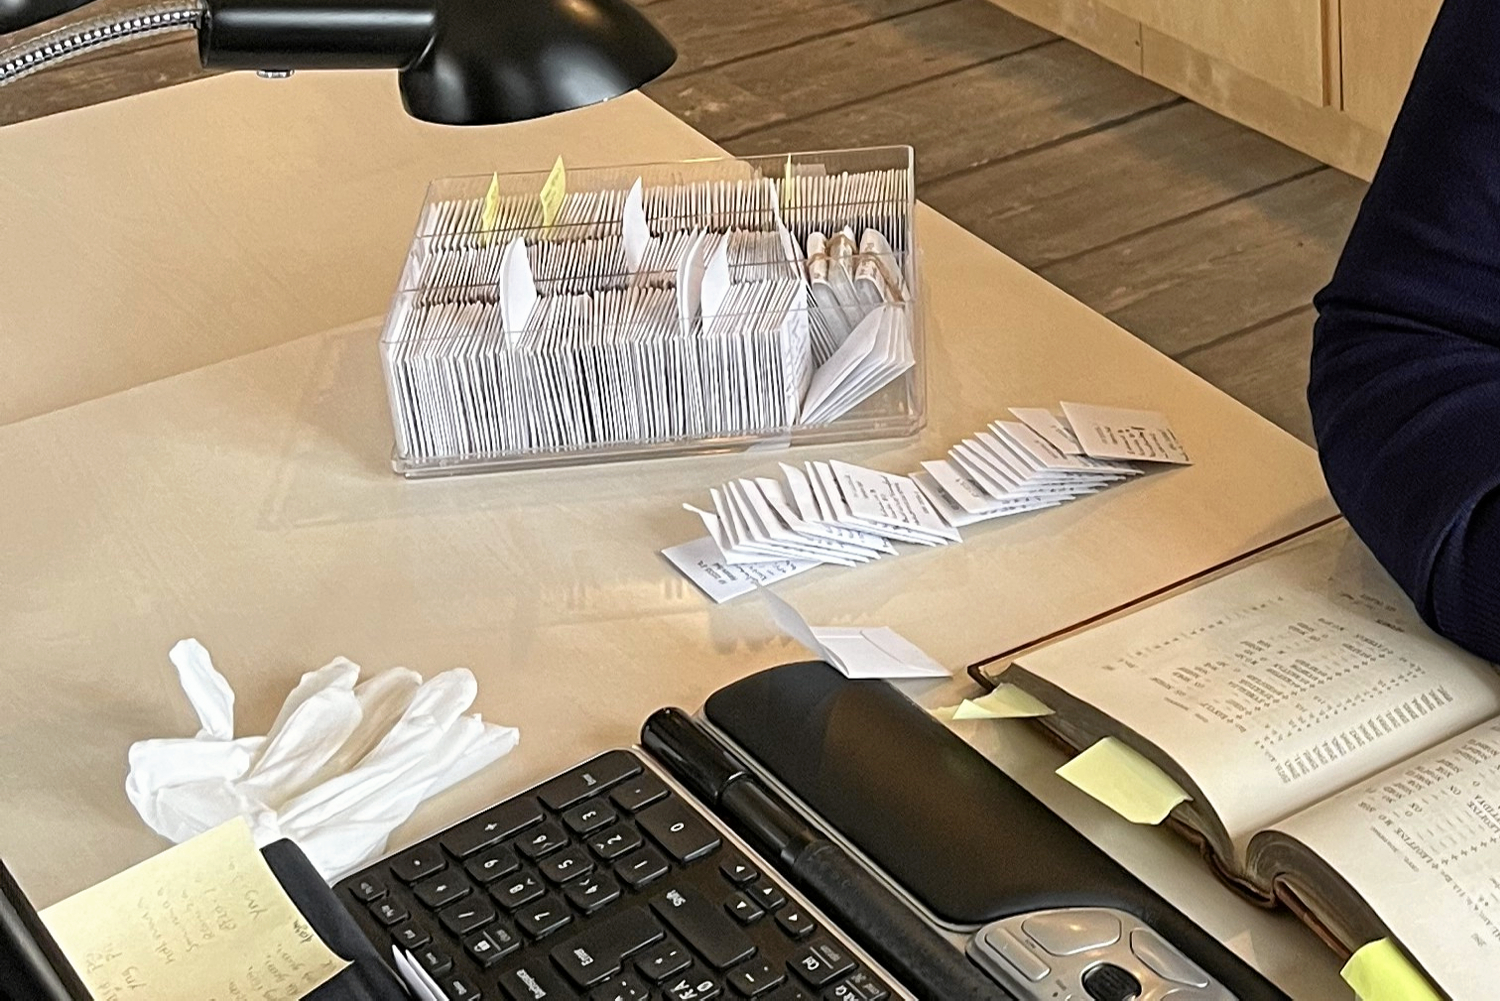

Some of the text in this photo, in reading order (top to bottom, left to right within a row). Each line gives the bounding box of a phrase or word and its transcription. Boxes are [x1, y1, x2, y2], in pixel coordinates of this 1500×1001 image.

[582, 810, 597, 821] 3
[607, 834, 622, 845] 2
[558, 859, 573, 870] 5
[534, 911, 550, 921] 7
